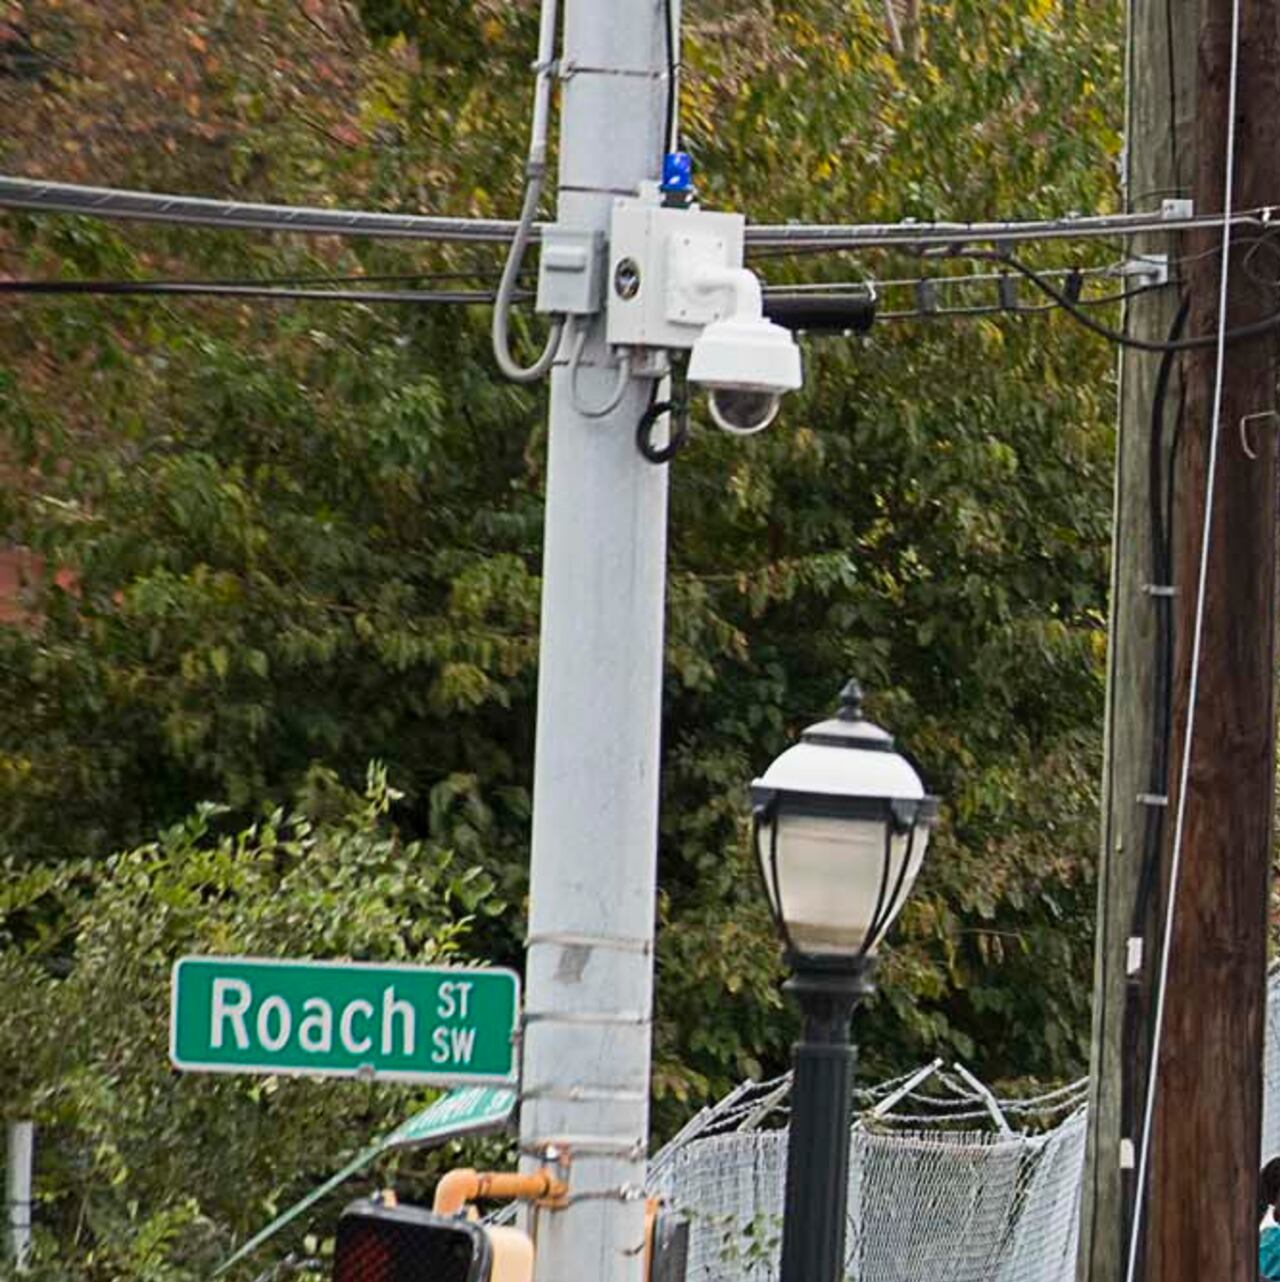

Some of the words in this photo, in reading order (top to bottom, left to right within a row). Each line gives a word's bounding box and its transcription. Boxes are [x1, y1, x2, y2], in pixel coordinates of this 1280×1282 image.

[209, 976, 416, 1056] Roach
[437, 981, 474, 1020] ST
[431, 1026, 476, 1065] SW
